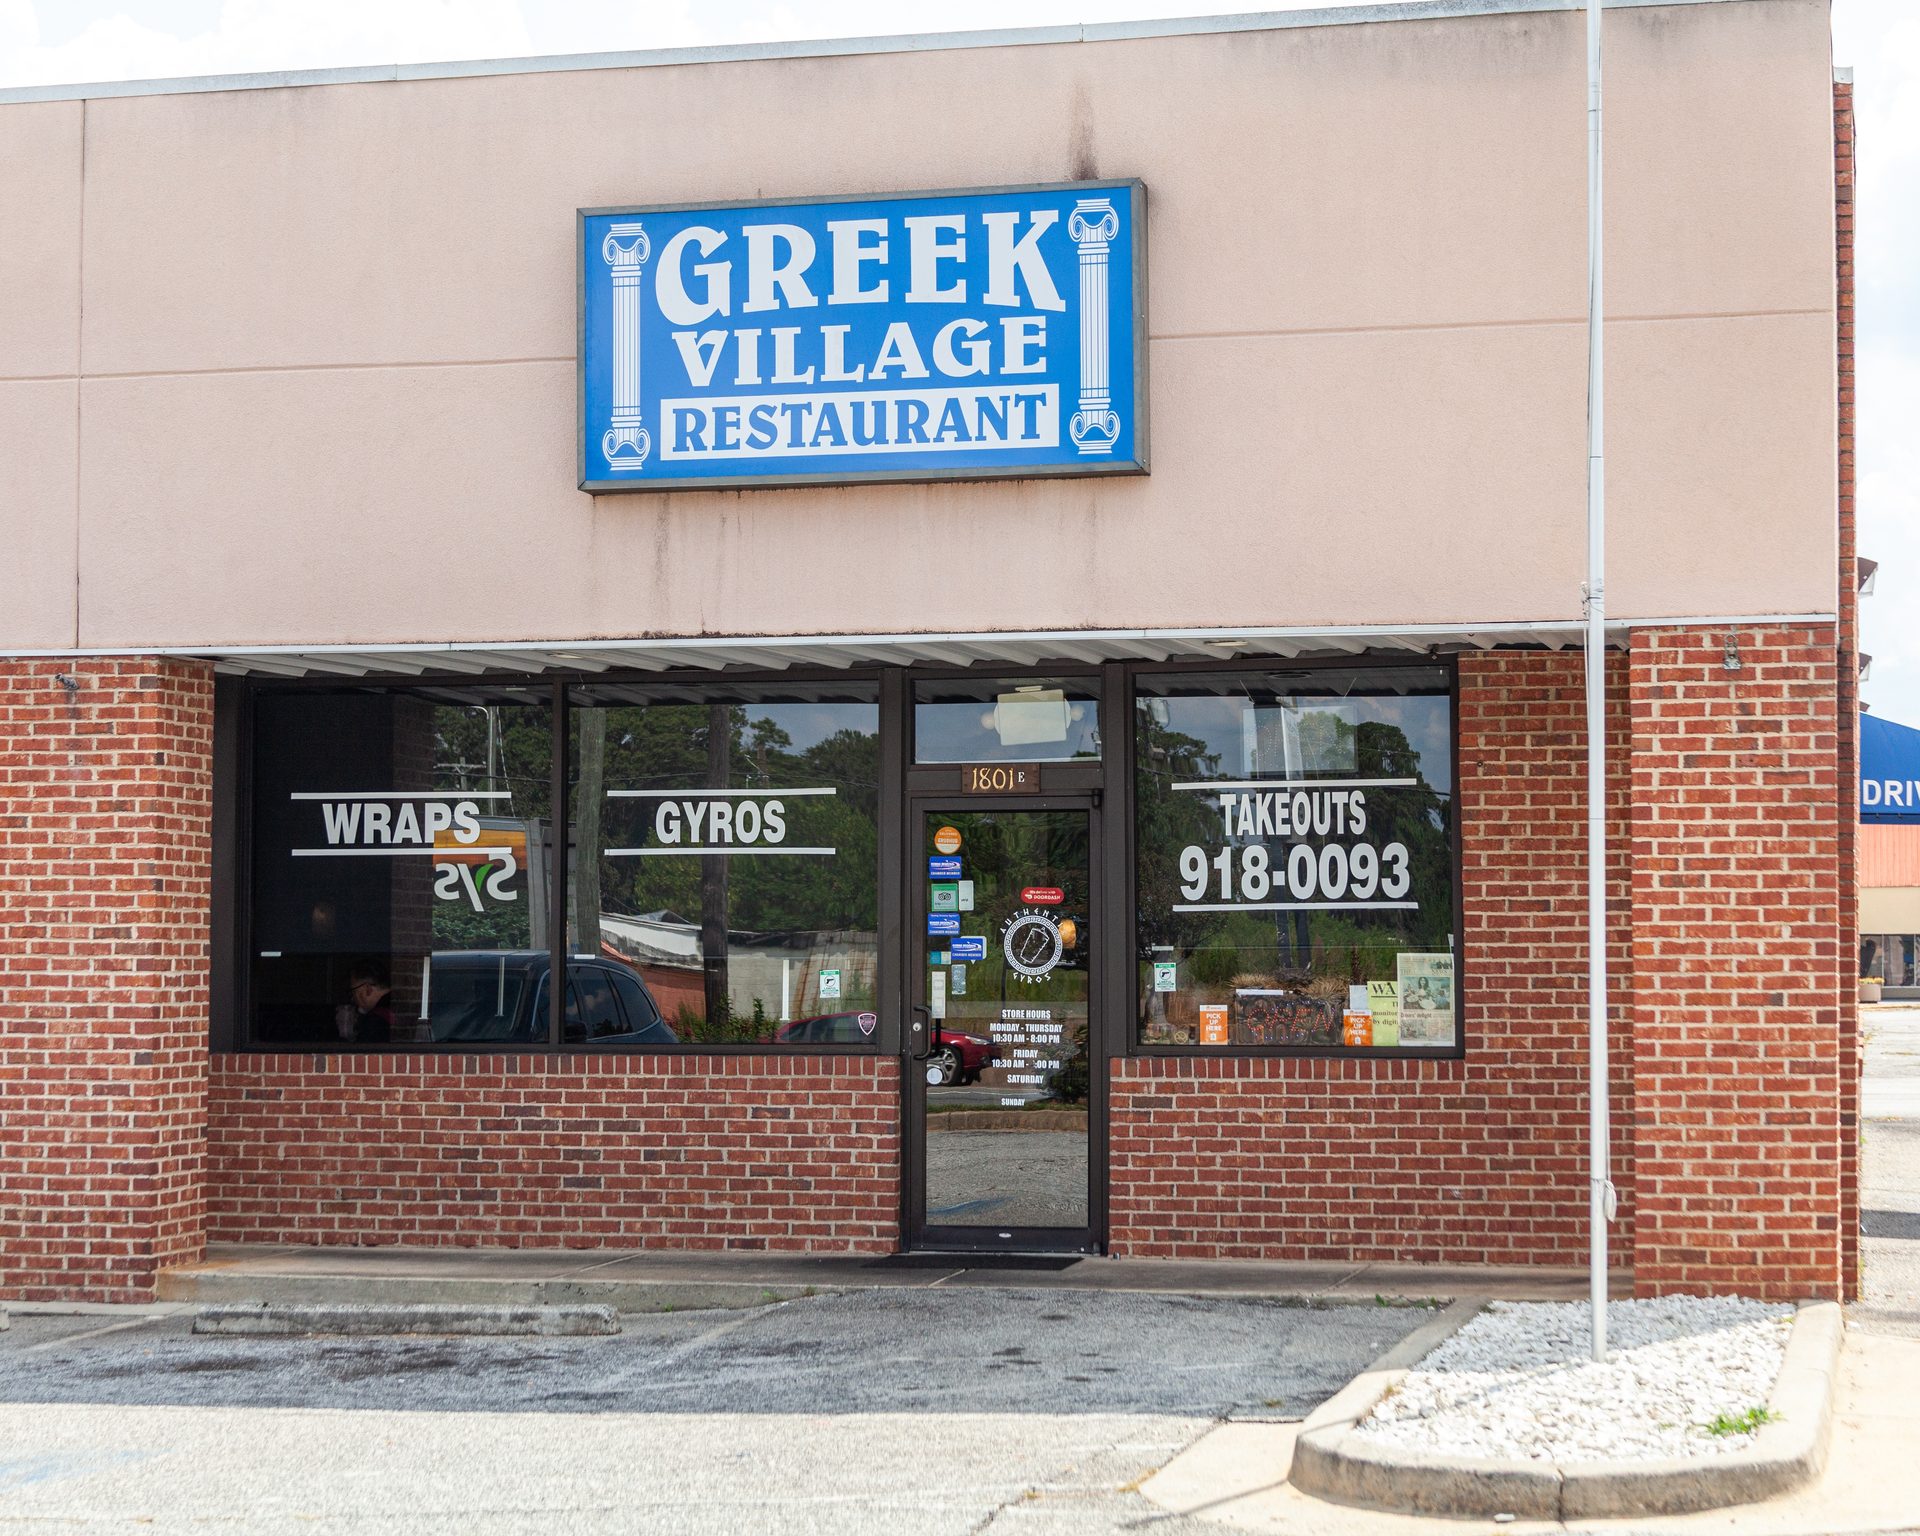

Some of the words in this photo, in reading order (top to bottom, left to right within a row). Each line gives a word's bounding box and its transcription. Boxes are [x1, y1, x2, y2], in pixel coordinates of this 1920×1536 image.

[655, 209, 1067, 326] GREEK
[672, 315, 1047, 388] VILLAGE
[671, 391, 1047, 453] RESTAURANT
[972, 767, 1014, 790] 1801
[1018, 771, 1025, 783] E
[1863, 779, 1920, 807] DRI
[322, 801, 481, 845] WRAPS
[655, 800, 786, 844] GYROS
[1219, 790, 1367, 837] TAKEOUTS
[1179, 842, 1411, 901] 918-0093
[1002, 1009, 1025, 1018] STORE
[1026, 1009, 1051, 1019] HOURS
[989, 1023, 1020, 1032] MONDAY
[1025, 1023, 1063, 1033] THURSDAY
[992, 1034, 1012, 1043] 10:30
[1013, 1034, 1025, 1043] AM
[1030, 1034, 1048, 1043] 8:00
[1048, 1035, 1060, 1044] PM
[991, 1059, 1012, 1068] 10:30
[1013, 1059, 1025, 1068] AM
[1048, 1060, 1060, 1069] PM
[1013, 1049, 1039, 1058] FRIDAY
[1007, 1074, 1044, 1084] SATURDAY
[1001, 1098, 1026, 1106] SUNDAY
